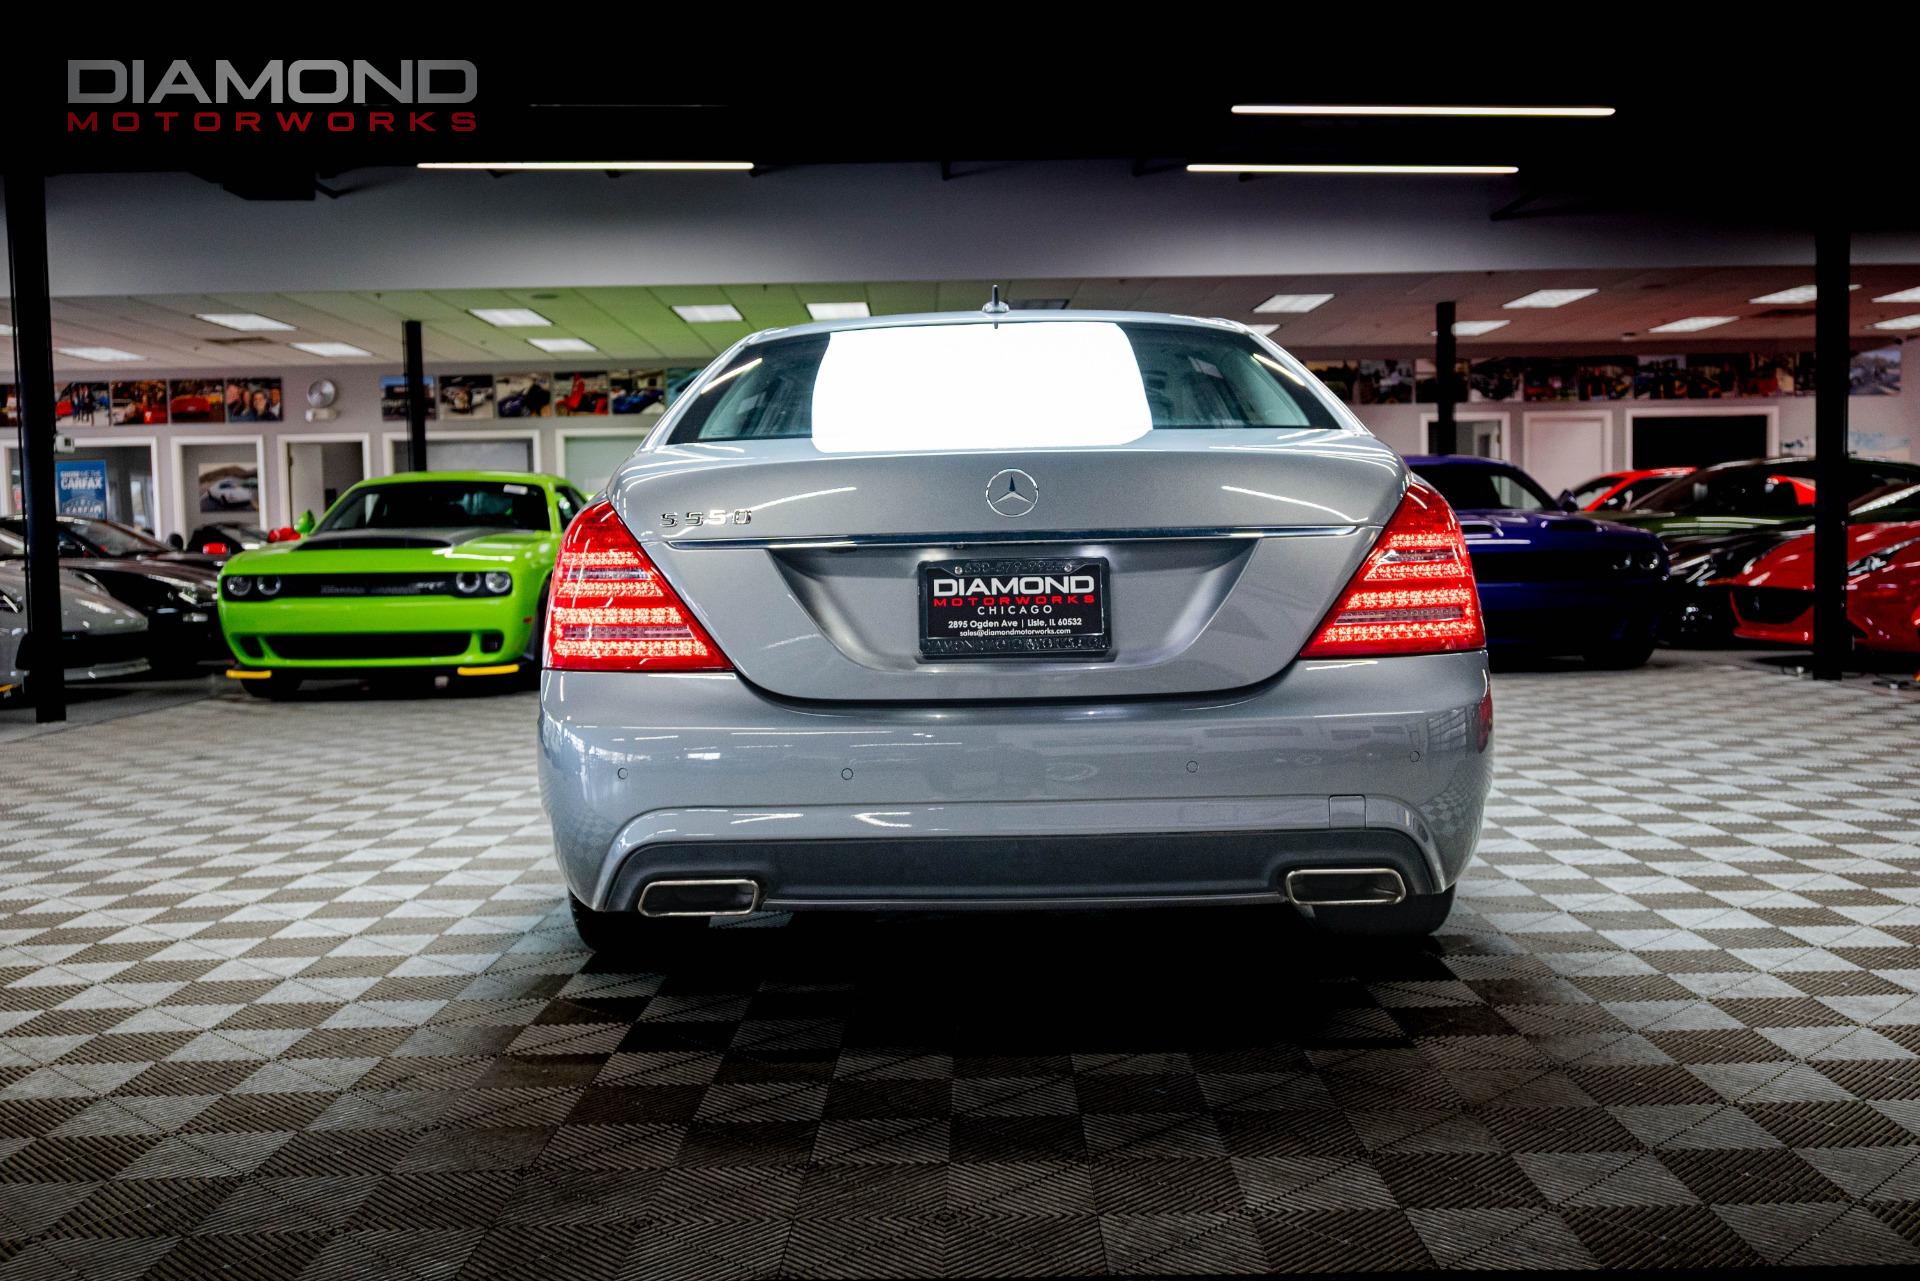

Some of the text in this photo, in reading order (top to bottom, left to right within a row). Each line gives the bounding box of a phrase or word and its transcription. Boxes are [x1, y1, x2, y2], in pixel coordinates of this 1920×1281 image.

[933, 575, 1095, 597] DIAMOND
[933, 595, 1095, 607] MOTORWORKS
[977, 605, 1053, 615] CHICAGO
[948, 620, 968, 629] 2895
[970, 620, 999, 630] Ogden
[1001, 619, 1018, 628] Ave
[1027, 618, 1047, 627] Lisle,
[1049, 618, 1056, 626] IL
[1057, 617, 1082, 627] 60532
[959, 628, 1071, 638] sales@diamondmotorworks.com
